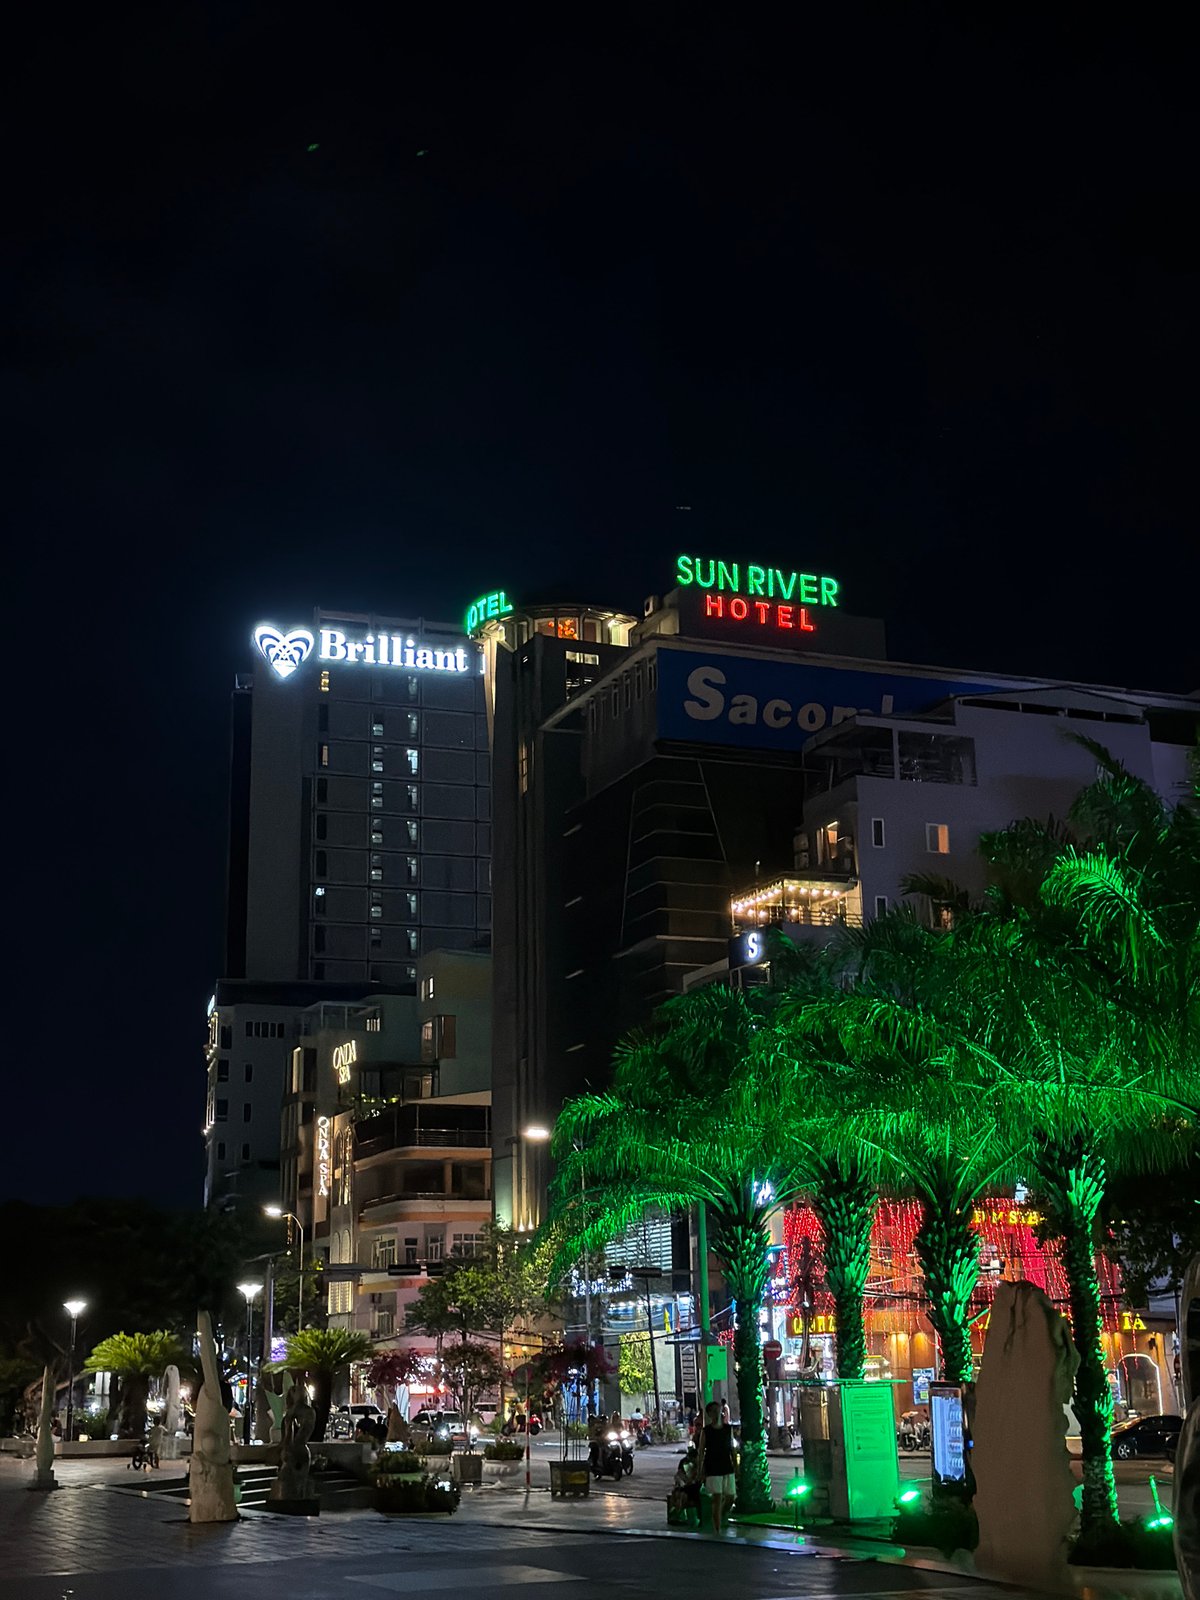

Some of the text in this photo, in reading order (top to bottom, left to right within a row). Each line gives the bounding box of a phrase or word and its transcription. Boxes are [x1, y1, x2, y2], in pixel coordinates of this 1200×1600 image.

[677, 556, 839, 607] SUN RIVER
[706, 594, 814, 631] HOTEL
[319, 629, 468, 672] Brilliant
[684, 666, 893, 732] Saco
[747, 932, 758, 958] S
[338, 1065, 351, 1084] SPA
[318, 1116, 329, 1196] ONDA SPA
